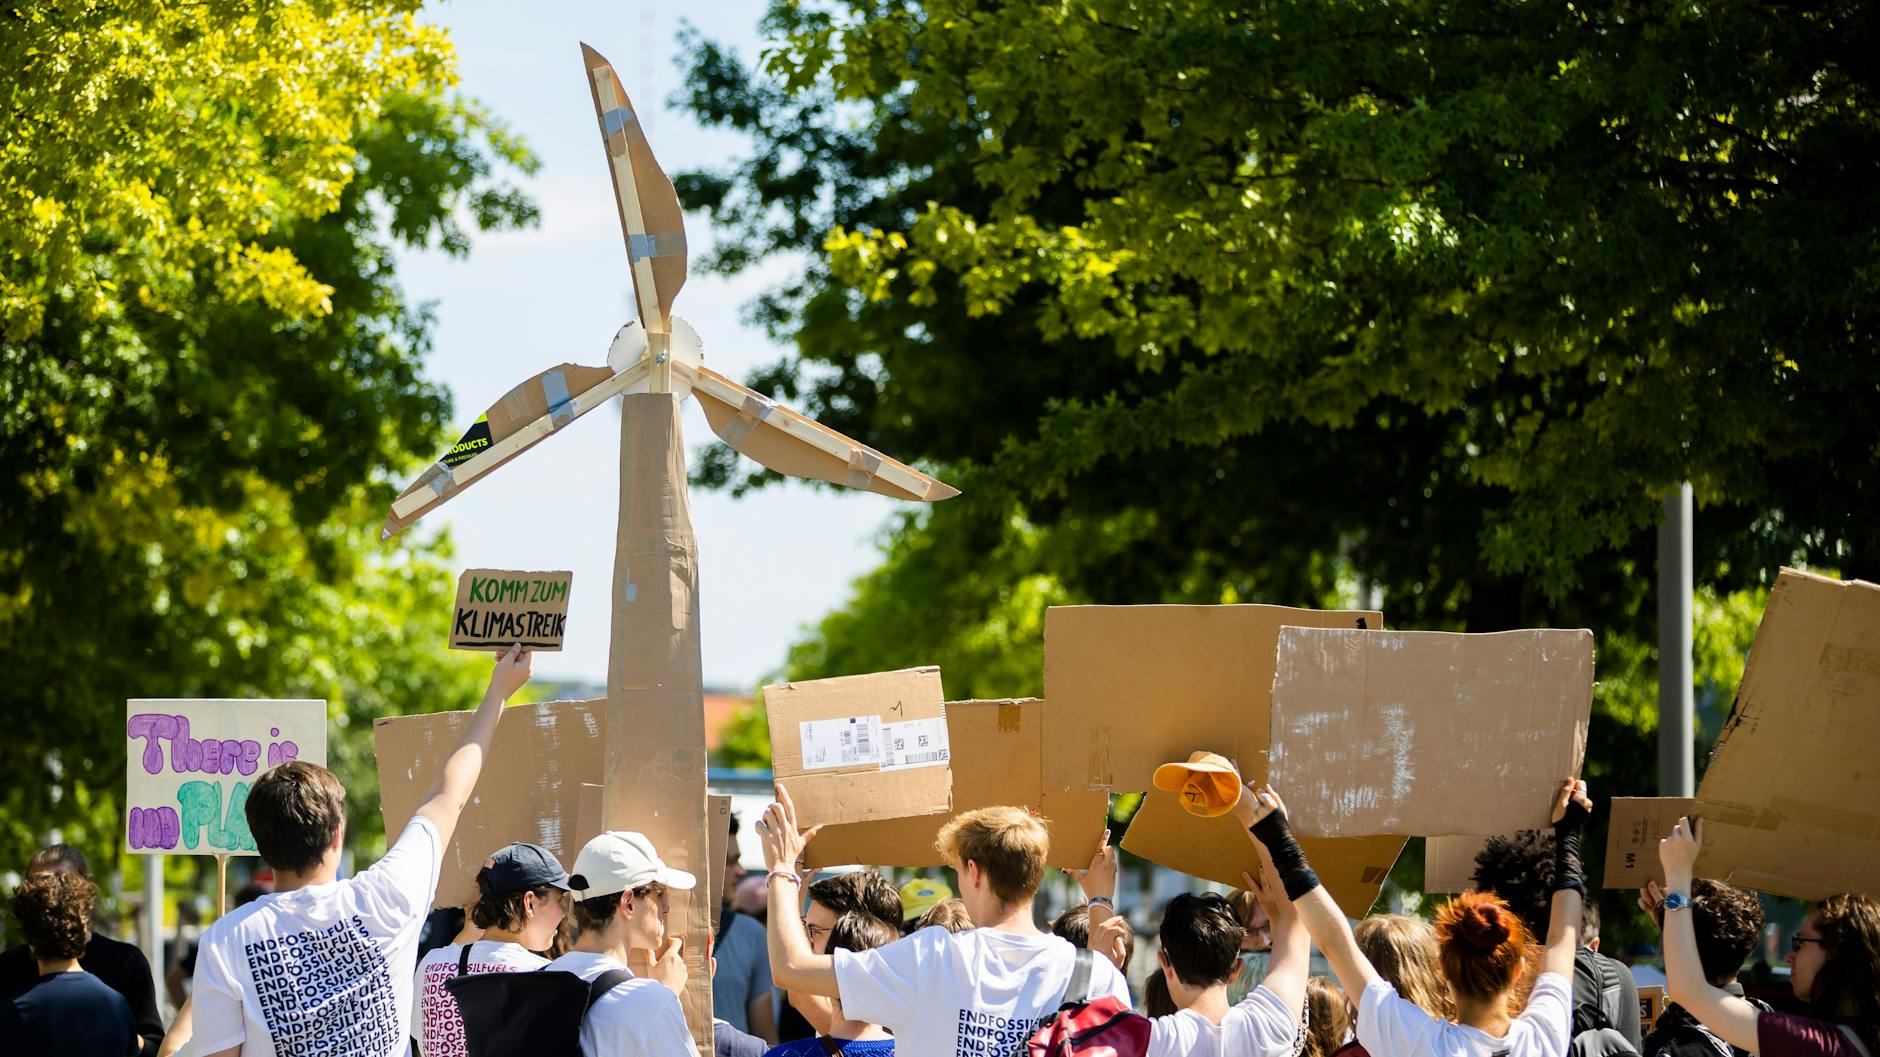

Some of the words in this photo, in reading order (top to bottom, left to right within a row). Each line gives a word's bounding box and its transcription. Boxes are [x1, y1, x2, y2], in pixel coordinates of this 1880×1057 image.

[469, 576, 528, 604] KOMM
[529, 580, 567, 603] ZUM
[455, 607, 567, 638] KLIMASTREIK
[128, 714, 261, 776] There
[177, 781, 258, 851] PLA
[245, 915, 363, 956] ENDFOSSILFUES
[425, 962, 518, 973] ENDFOSILFUELS
